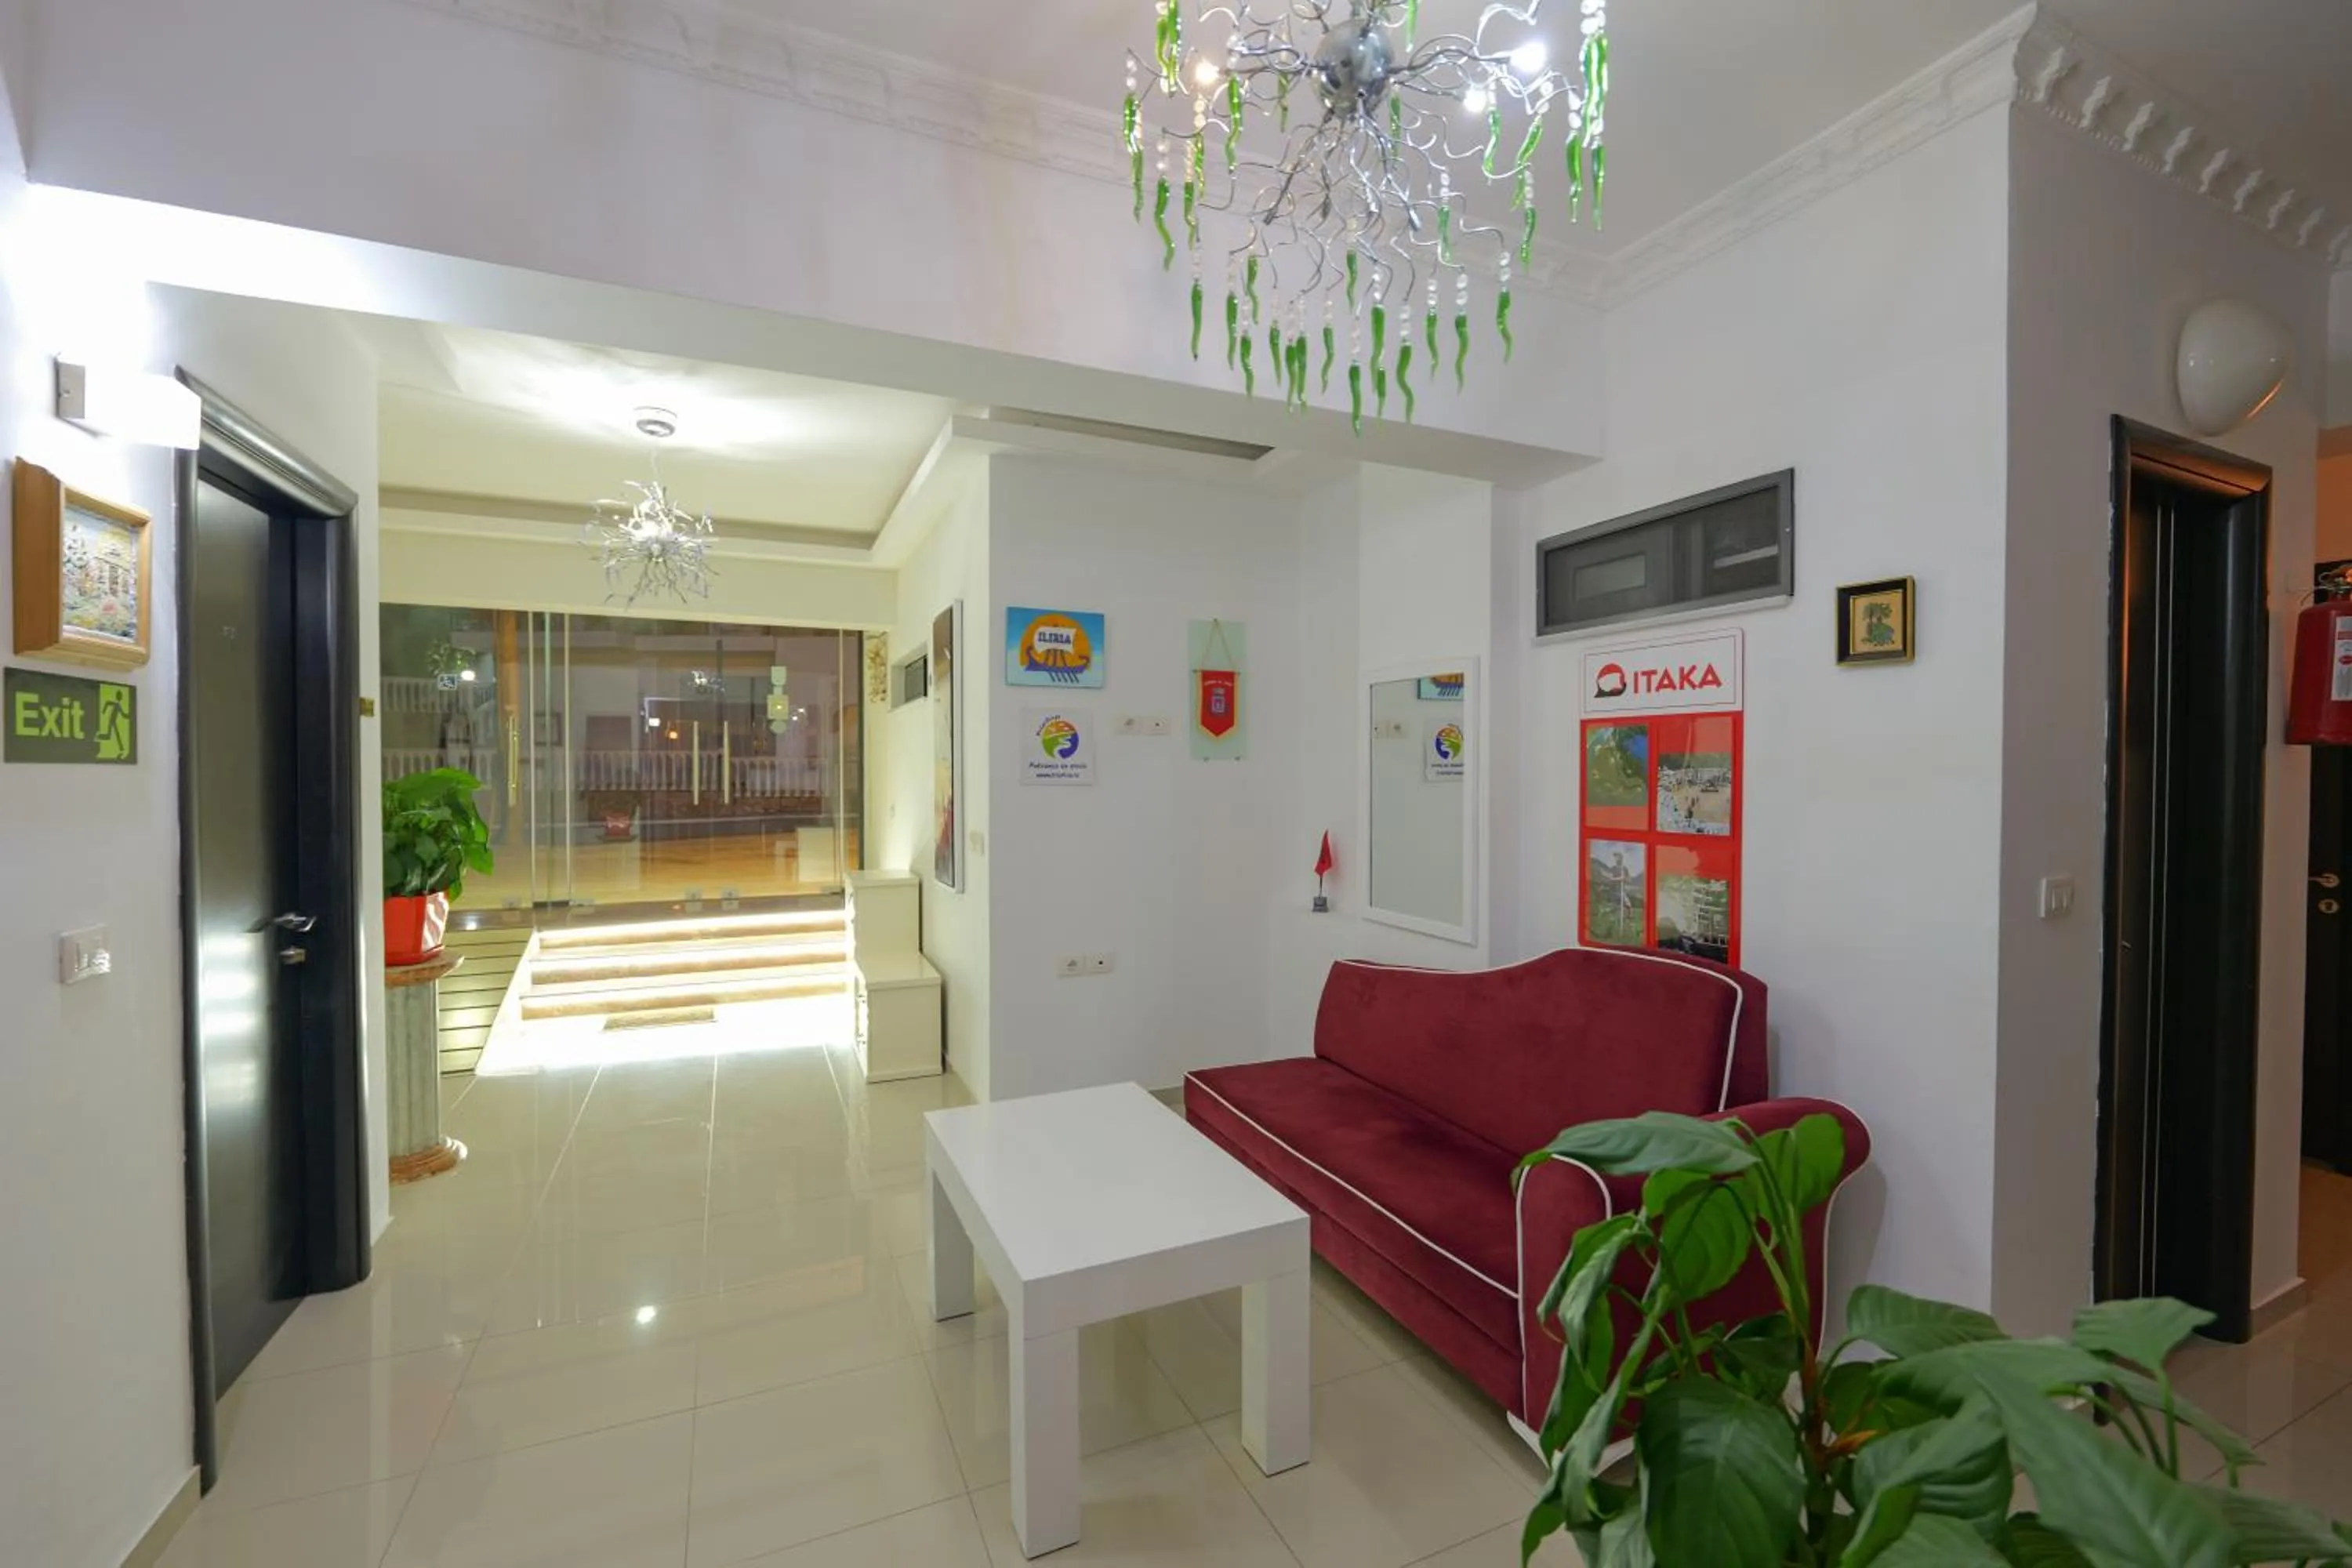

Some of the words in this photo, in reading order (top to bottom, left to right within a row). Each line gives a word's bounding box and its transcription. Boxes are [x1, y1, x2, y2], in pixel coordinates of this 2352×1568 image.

[1037, 631, 1072, 645] ILIRIA
[1633, 663, 1722, 694] ITAKA
[15, 691, 85, 739] Exit
